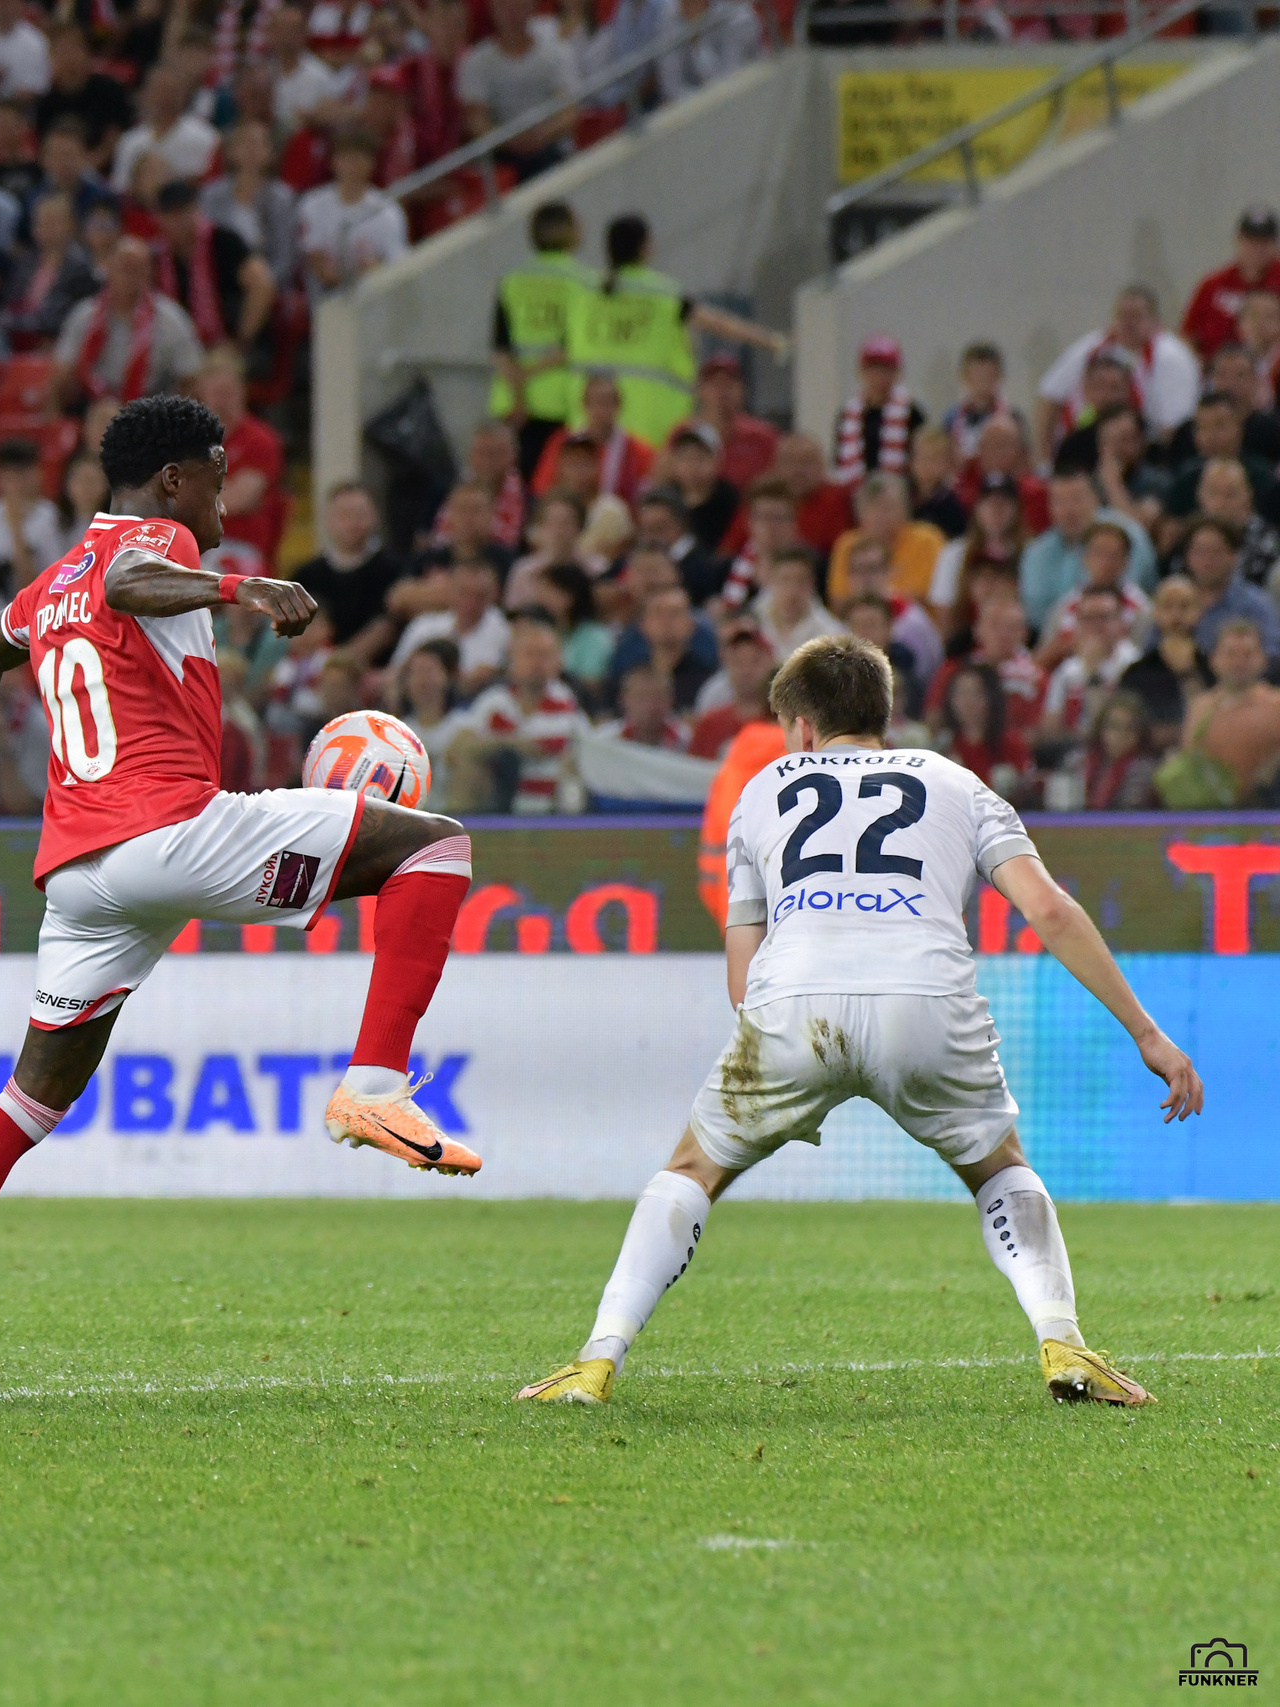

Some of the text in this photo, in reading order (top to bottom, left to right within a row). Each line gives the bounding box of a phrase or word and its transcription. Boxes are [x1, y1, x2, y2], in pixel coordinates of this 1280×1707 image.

[37, 637, 118, 785] 10
[776, 755, 926, 778] КАККОЕВ
[777, 772, 927, 889] 22
